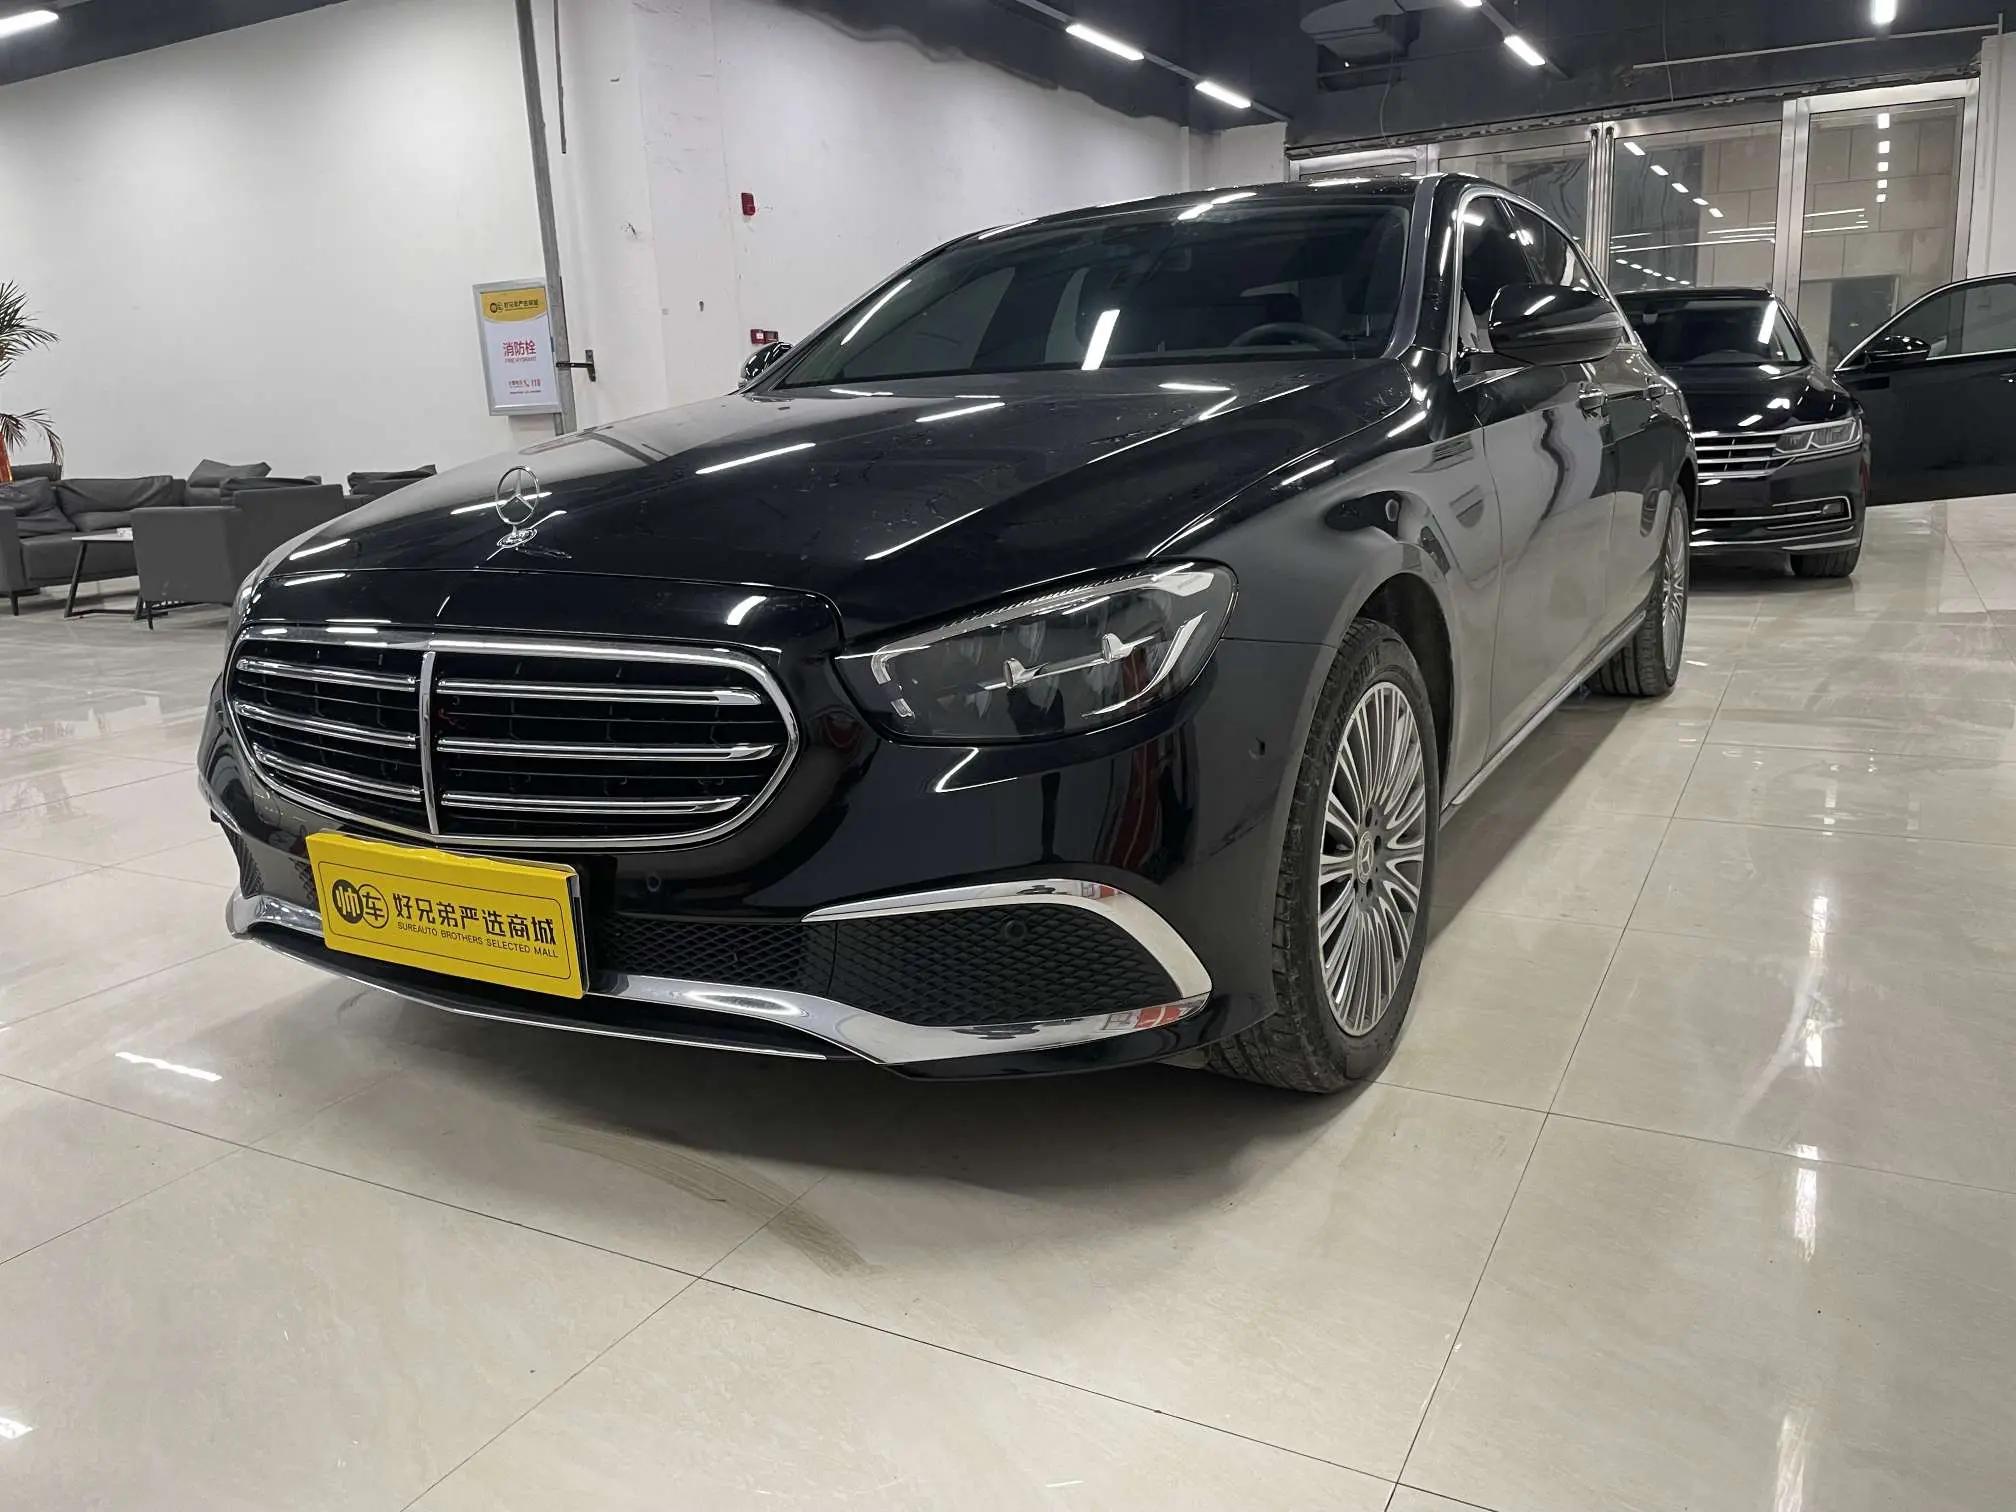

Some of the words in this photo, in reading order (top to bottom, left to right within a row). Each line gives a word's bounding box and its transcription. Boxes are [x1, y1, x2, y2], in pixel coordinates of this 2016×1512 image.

[502, 340, 537, 357] 消防栓
[393, 893, 557, 945] 好兄弟严选商城
[398, 921, 438, 936] SUREAUTO
[441, 929, 483, 946] BROTHERS
[486, 938, 531, 954] SELECTED
[533, 946, 559, 958] MALL
